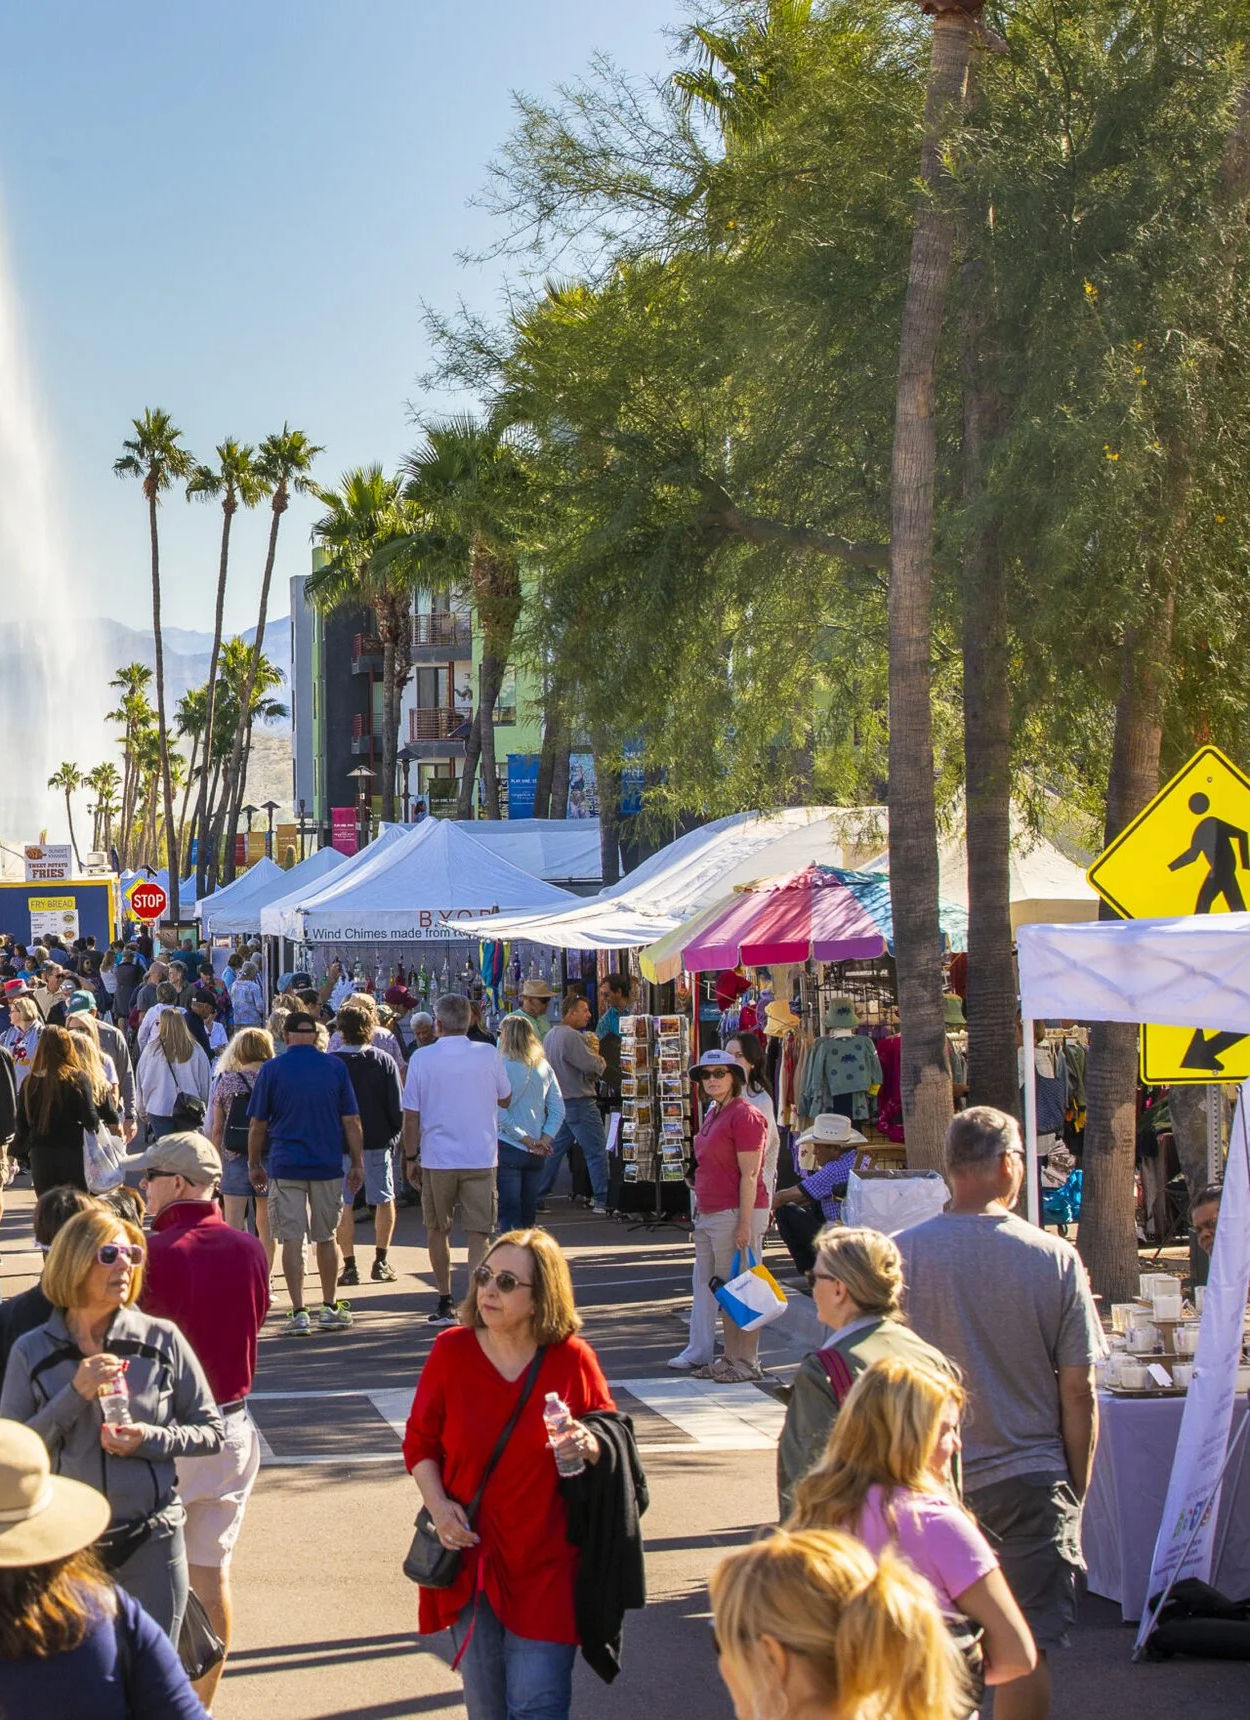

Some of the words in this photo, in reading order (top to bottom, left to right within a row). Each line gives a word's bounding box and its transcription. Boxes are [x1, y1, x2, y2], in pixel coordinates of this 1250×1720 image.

[501, 779, 509, 802] HILLS
[32, 868, 65, 879] FRIES
[30, 900, 46, 909] FRY
[47, 899, 74, 908] BREAD
[134, 894, 164, 908] STOP
[312, 928, 341, 939] Wind
[344, 927, 387, 939] Chimes
[390, 928, 422, 939] made
[425, 927, 450, 938] from
